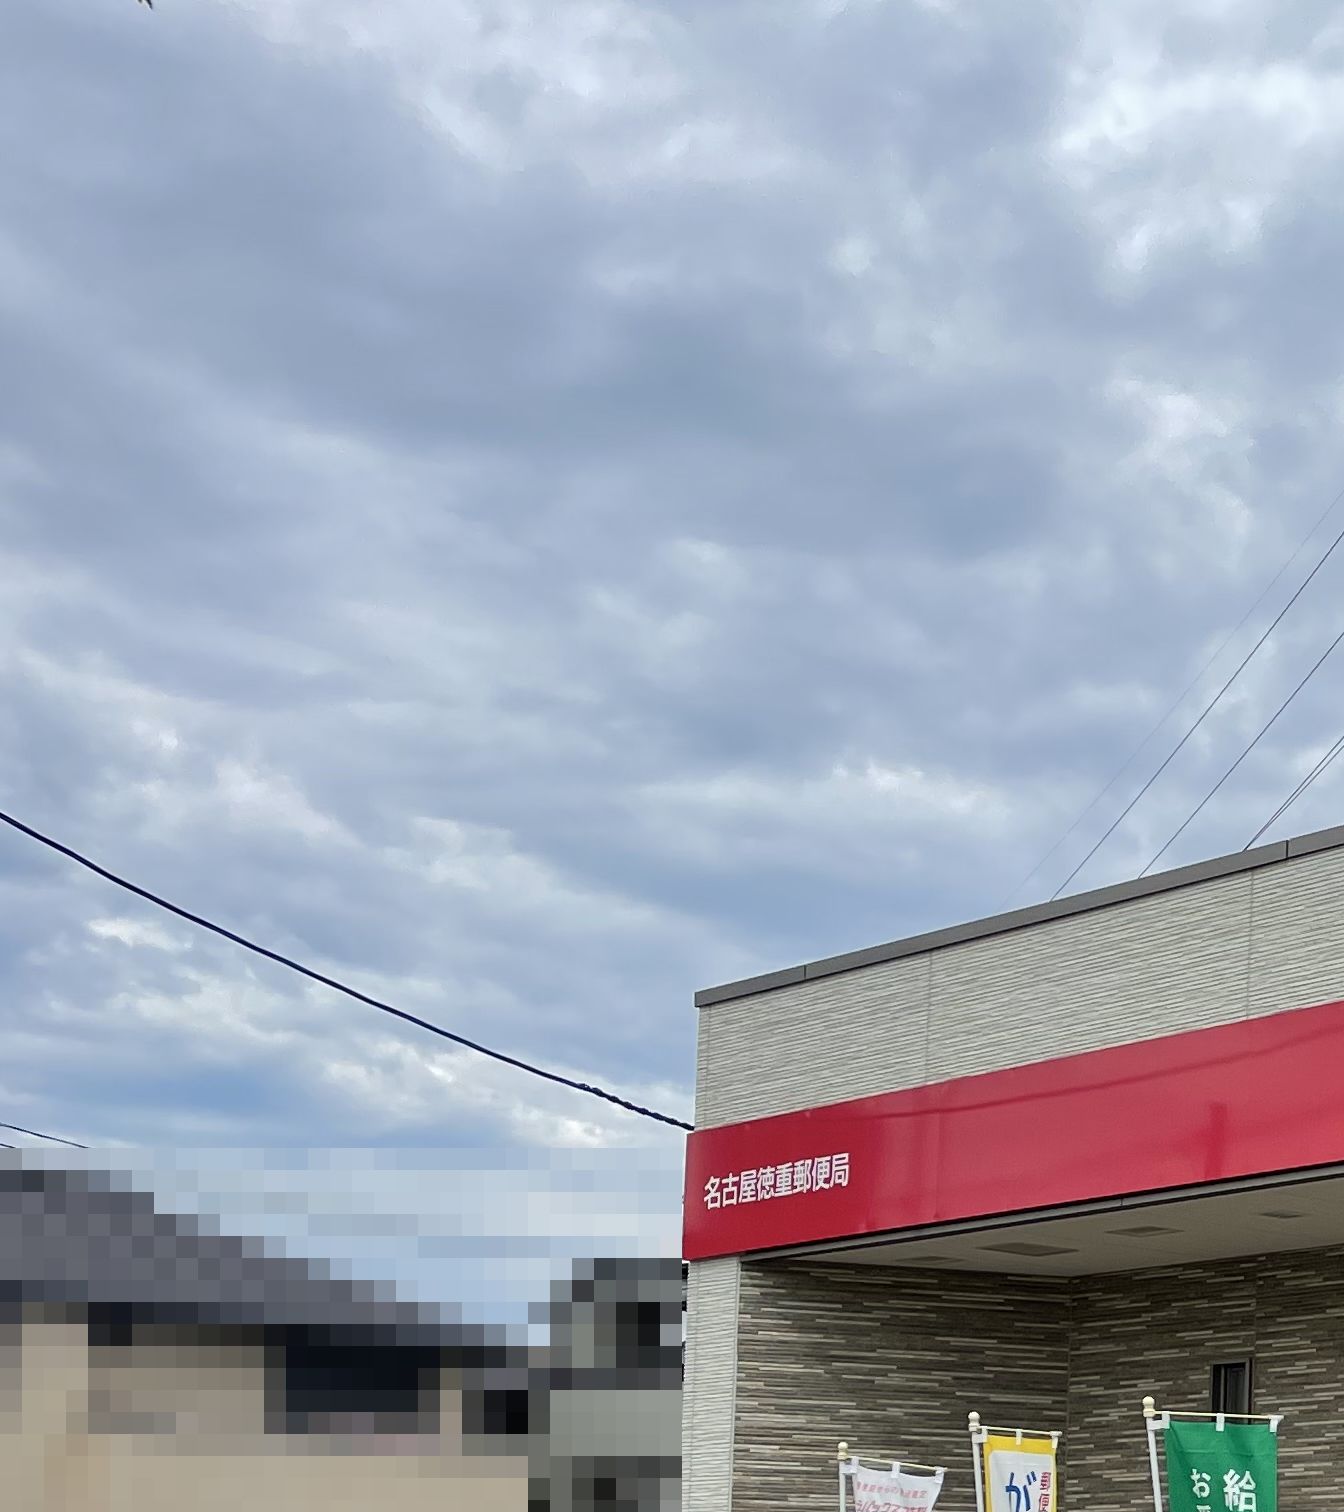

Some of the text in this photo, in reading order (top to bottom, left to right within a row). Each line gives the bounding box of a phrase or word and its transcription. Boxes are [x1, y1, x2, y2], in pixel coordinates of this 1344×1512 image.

[703, 1152, 850, 1211] 名古屋徳重郵便局
